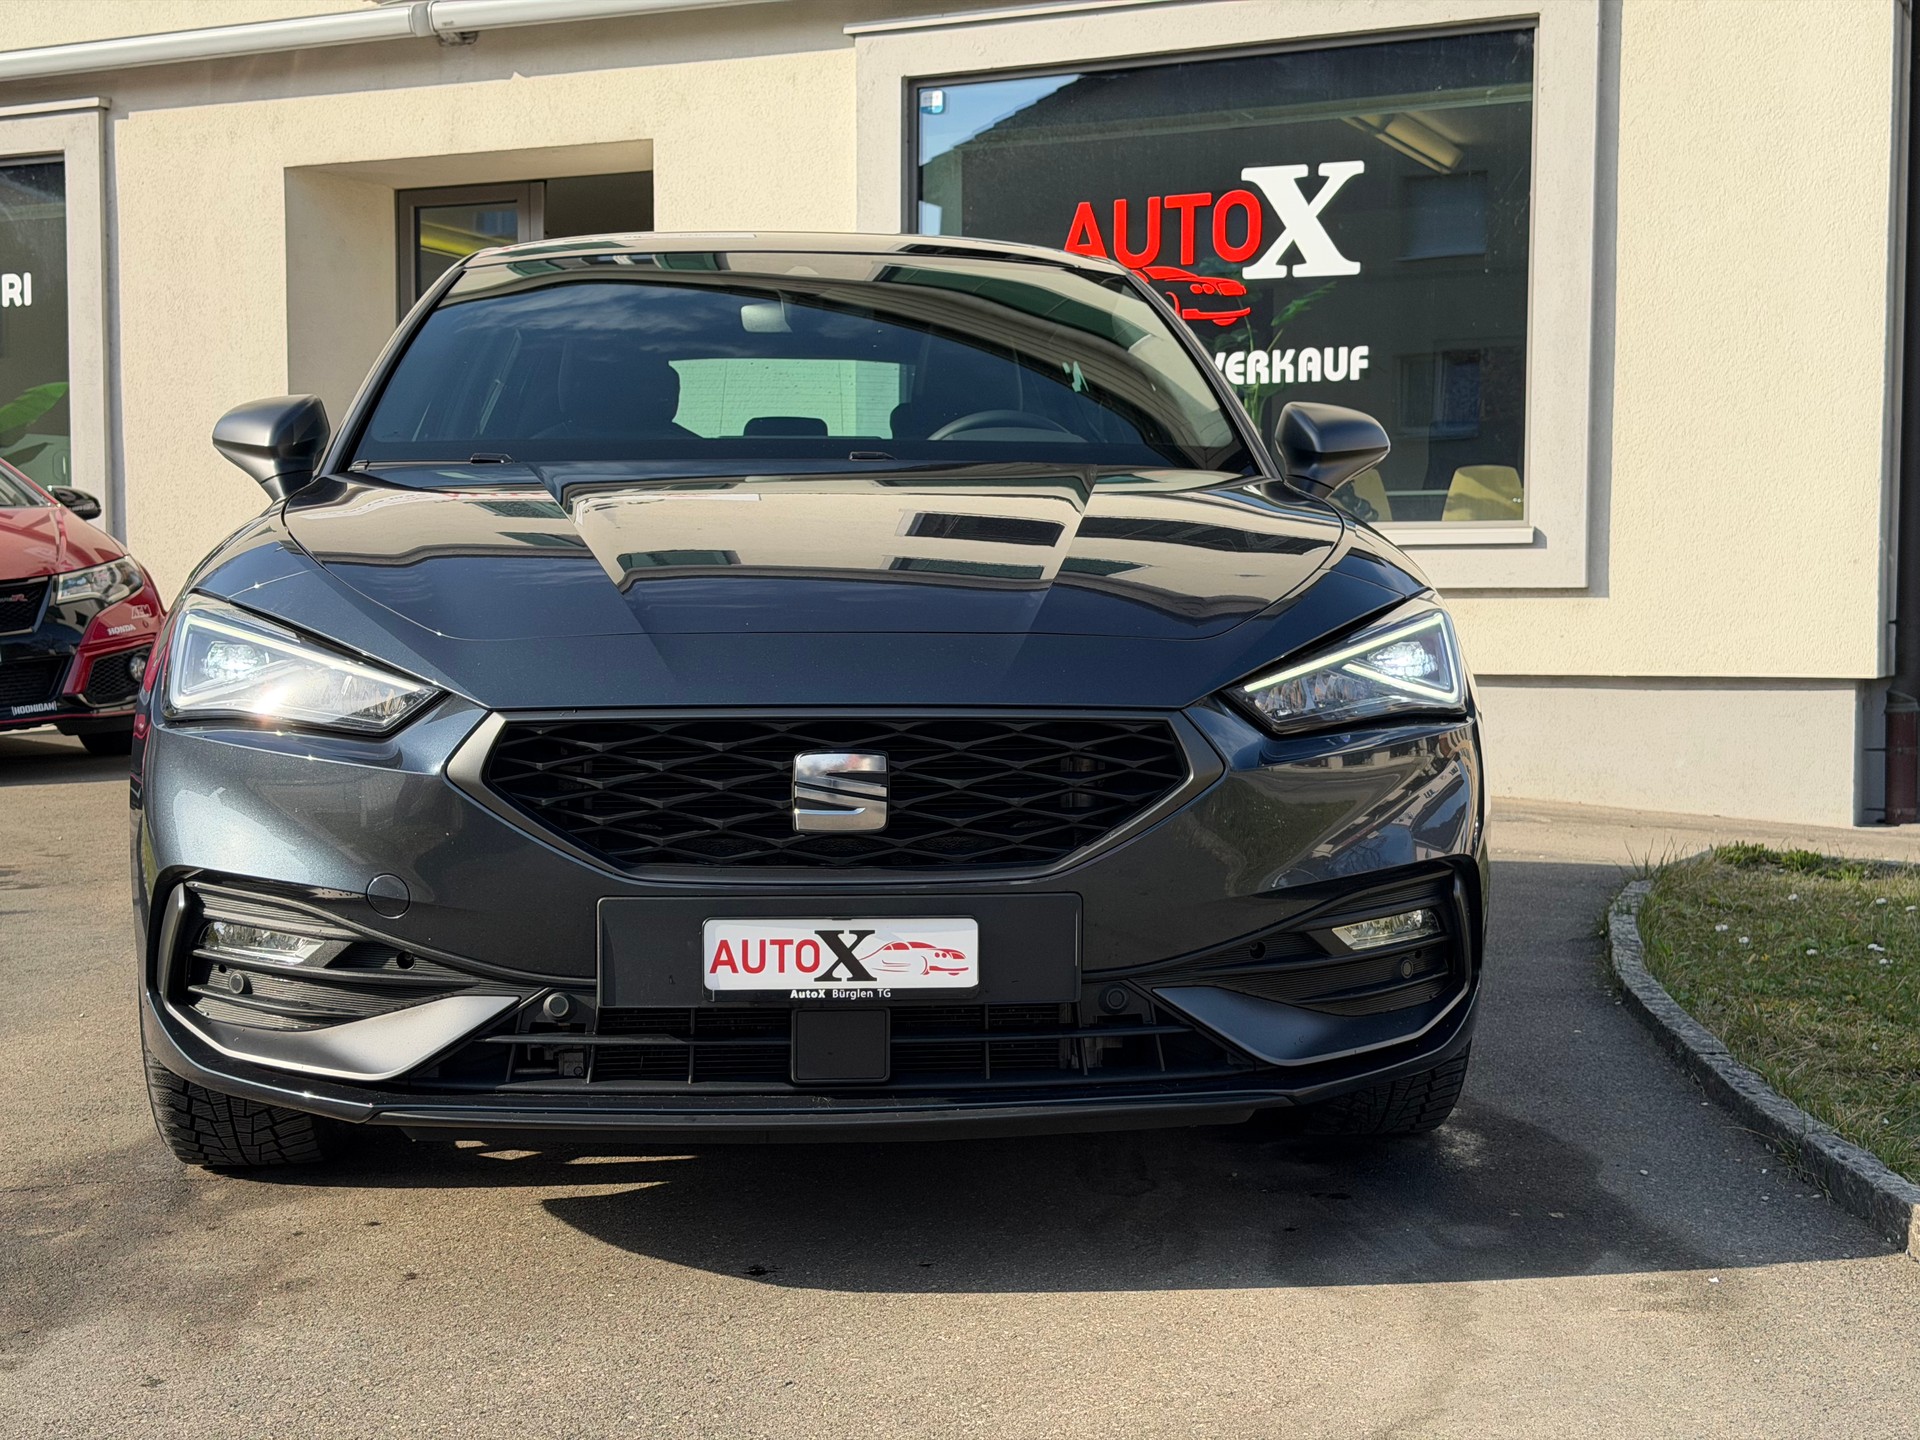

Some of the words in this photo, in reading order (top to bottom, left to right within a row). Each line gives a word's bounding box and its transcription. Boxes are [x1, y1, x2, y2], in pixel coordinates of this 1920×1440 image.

[1, 272, 32, 308] RI
[107, 624, 137, 636] HONDA
[790, 989, 826, 999] AutoX
[832, 988, 873, 1000] Bürglen
[877, 988, 891, 998] TG
